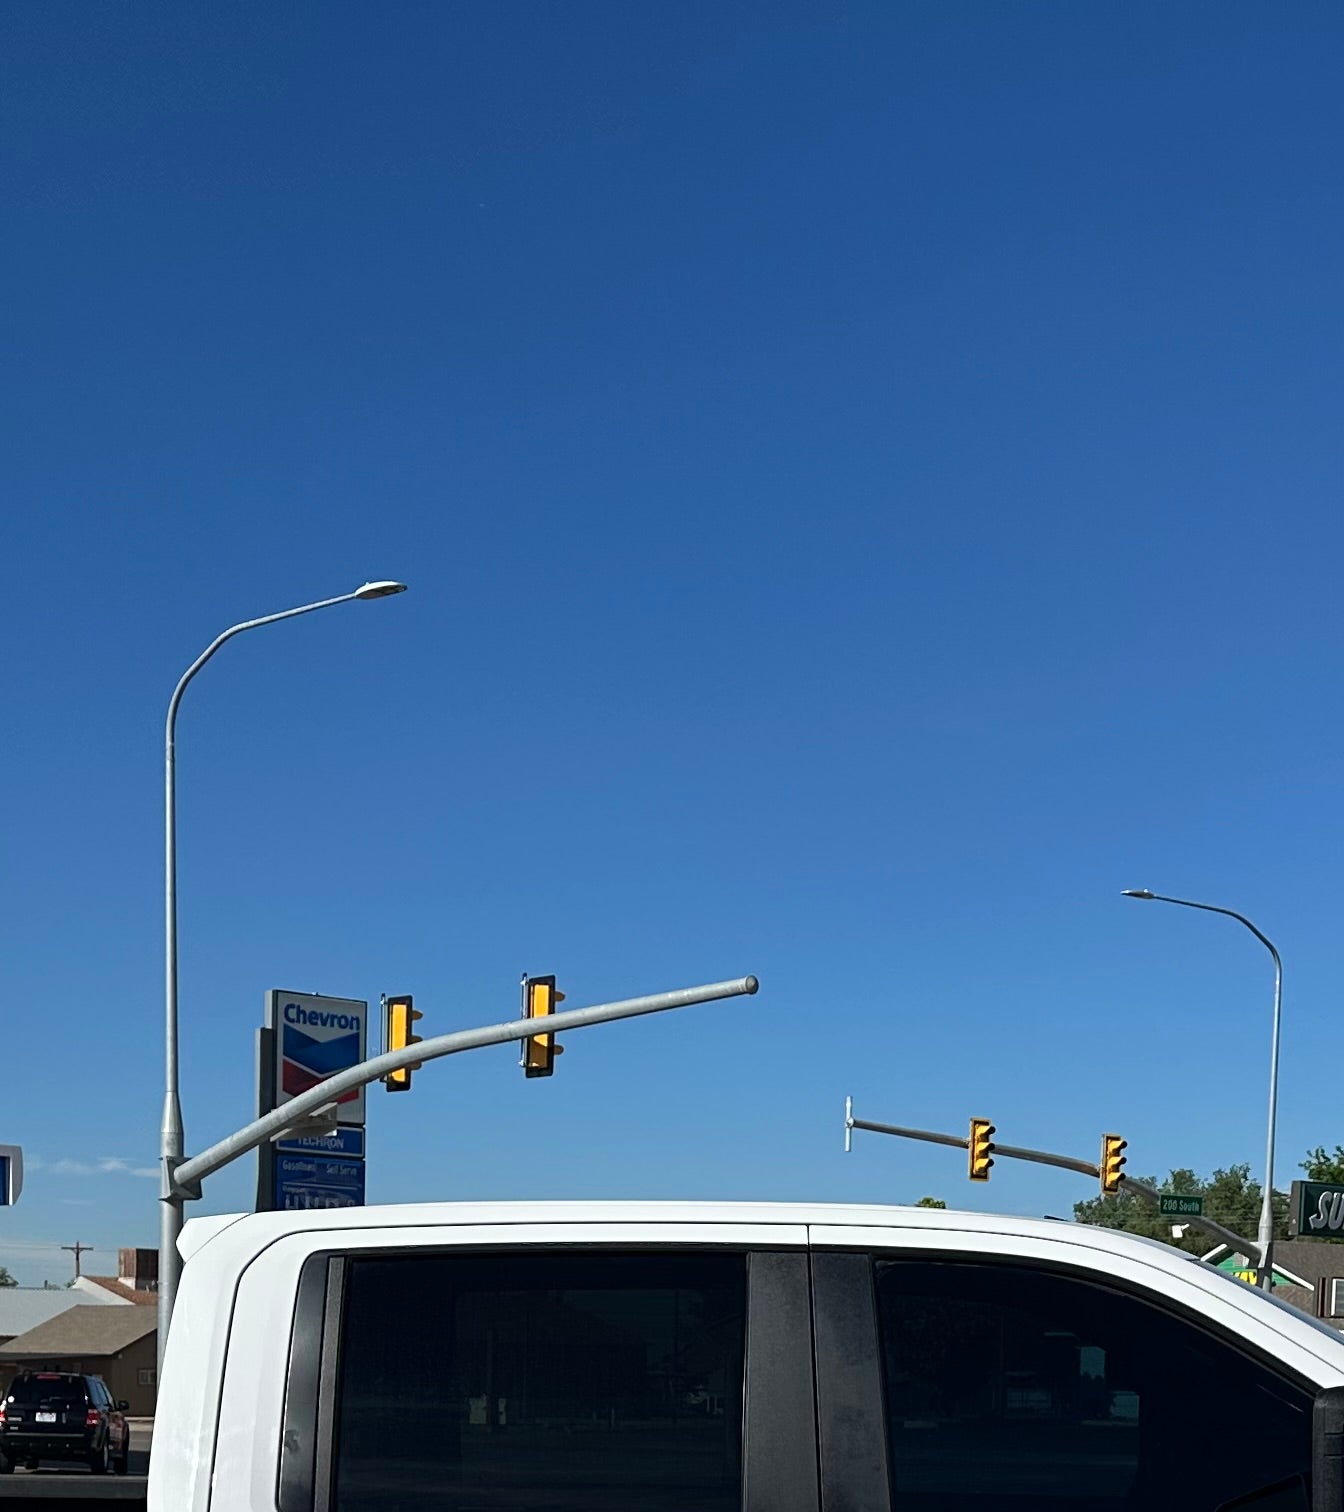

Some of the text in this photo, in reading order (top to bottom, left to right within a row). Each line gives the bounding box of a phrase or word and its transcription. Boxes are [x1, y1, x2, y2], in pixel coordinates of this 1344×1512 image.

[284, 1003, 361, 1030] Chevron
[1162, 1199, 1200, 1212] 200 South
